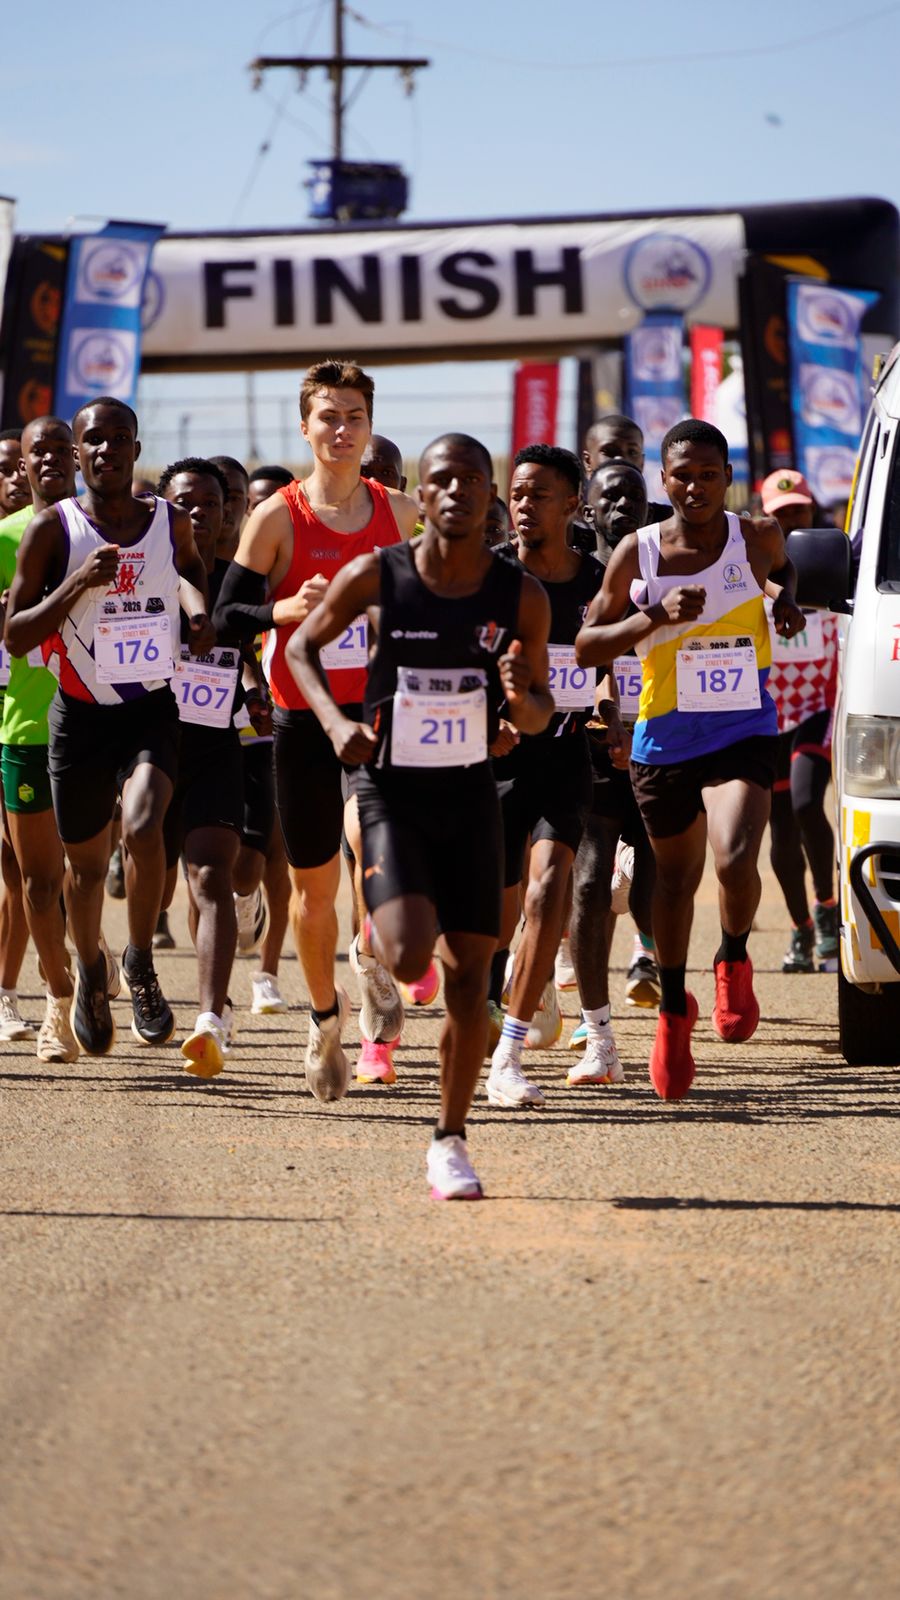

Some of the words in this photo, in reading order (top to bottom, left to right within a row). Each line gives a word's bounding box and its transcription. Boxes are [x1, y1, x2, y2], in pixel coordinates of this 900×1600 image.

[204, 246, 585, 329] FINISH
[724, 581, 747, 590] ASPIRE
[122, 601, 142, 612] 2026
[404, 630, 438, 639] lotto
[114, 638, 160, 665] 176
[548, 667, 587, 690] 210
[696, 668, 743, 693] 187
[182, 682, 229, 709] 107
[420, 717, 466, 744] 211
